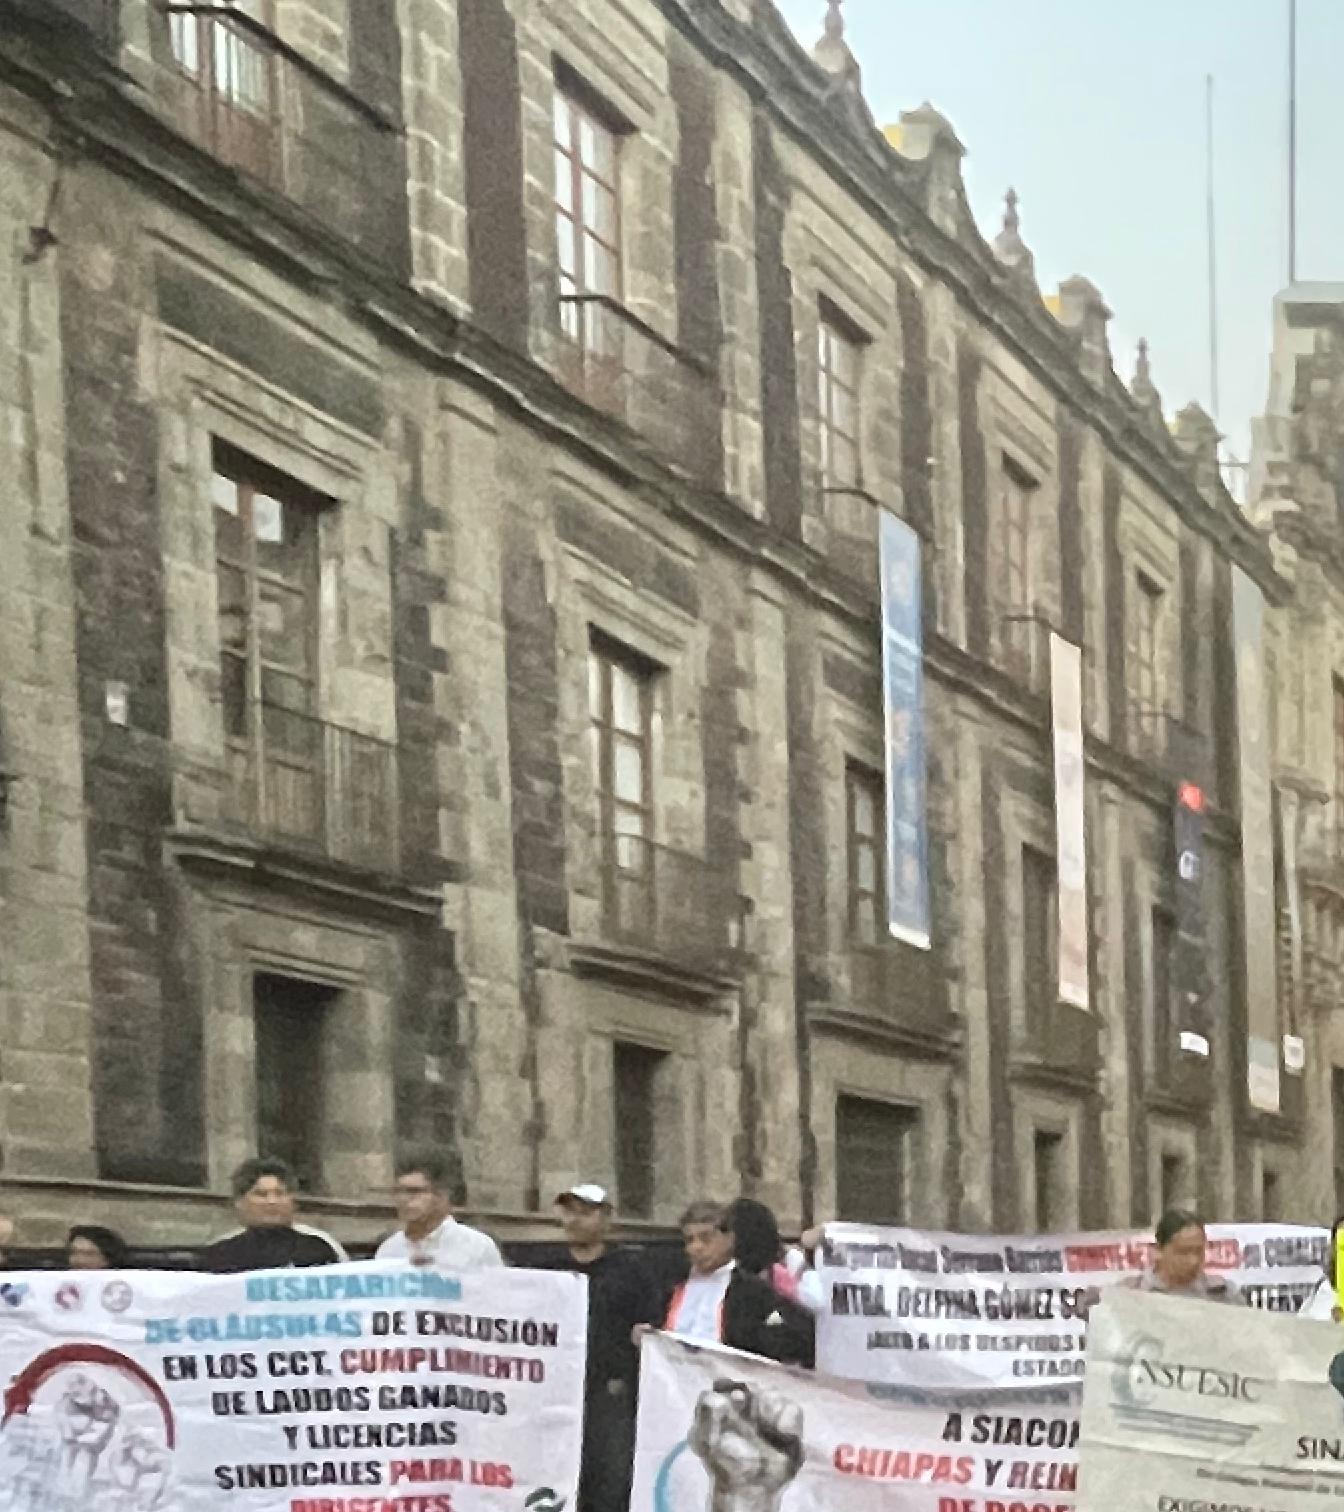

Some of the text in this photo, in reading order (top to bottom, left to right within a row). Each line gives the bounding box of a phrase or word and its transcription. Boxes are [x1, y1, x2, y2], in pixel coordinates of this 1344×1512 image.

[372, 1311, 406, 1335] DE
[416, 1310, 559, 1347] EXCLUSIÓN
[163, 1355, 197, 1381] EN
[206, 1353, 257, 1378] LOS
[340, 1348, 545, 1383] CUMPLIMIENTO
[212, 1385, 507, 1415] DE LAUDOS GANADOS
[283, 1421, 458, 1449] Y LICENCIAS
[942, 1412, 962, 1442] A
[214, 1457, 513, 1490] SINDICALES PARA LOS
[834, 1443, 976, 1484] CHIAPAS
[984, 1458, 1003, 1487] Y
